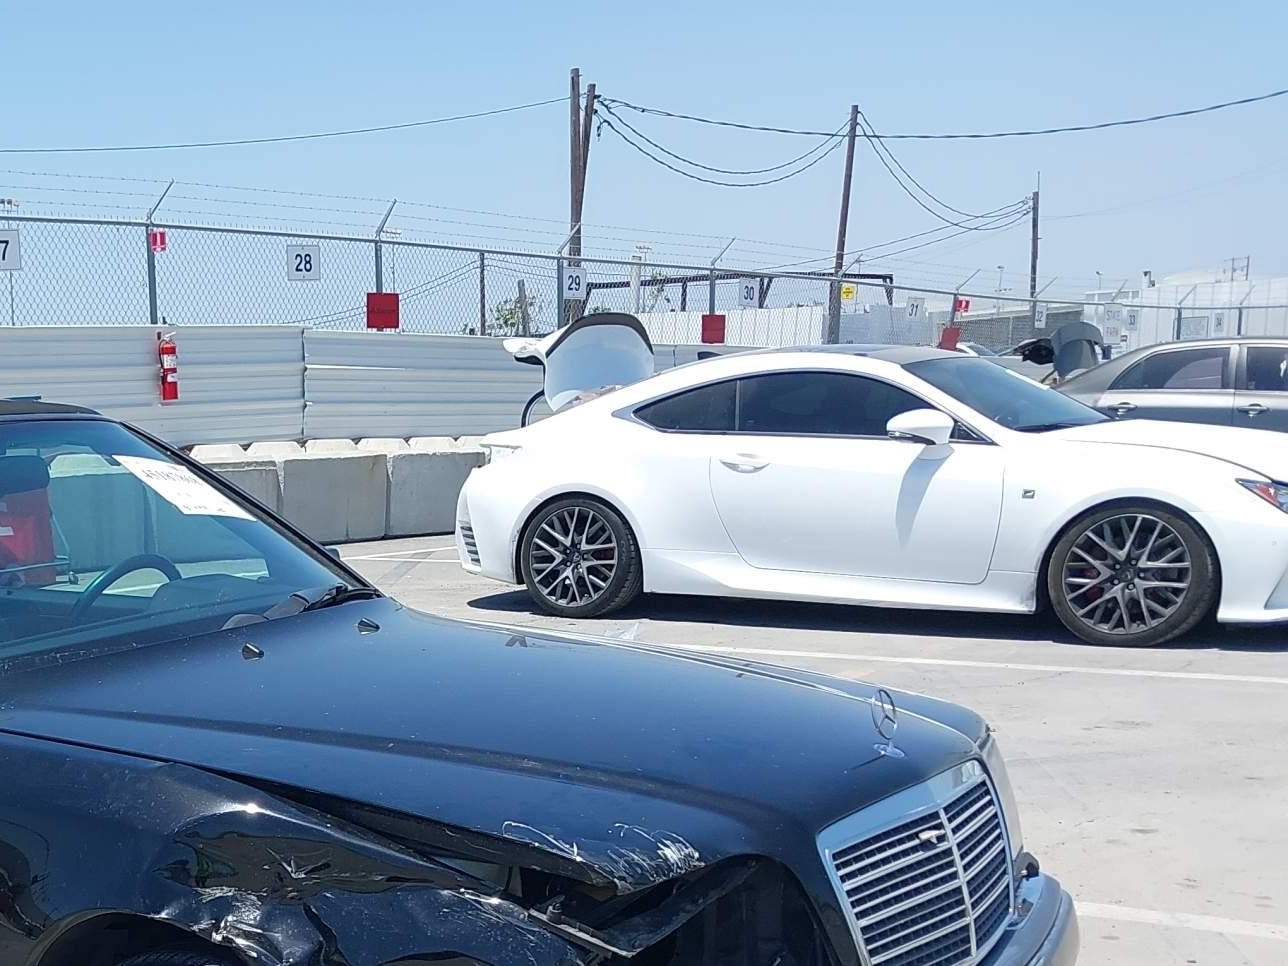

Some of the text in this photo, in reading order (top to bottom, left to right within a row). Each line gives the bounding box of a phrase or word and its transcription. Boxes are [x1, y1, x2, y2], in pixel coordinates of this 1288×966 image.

[295, 254, 312, 272] 28
[568, 275, 580, 291] 29
[743, 285, 754, 301] 30
[909, 303, 919, 317] 31
[1128, 313, 1136, 326] 33
